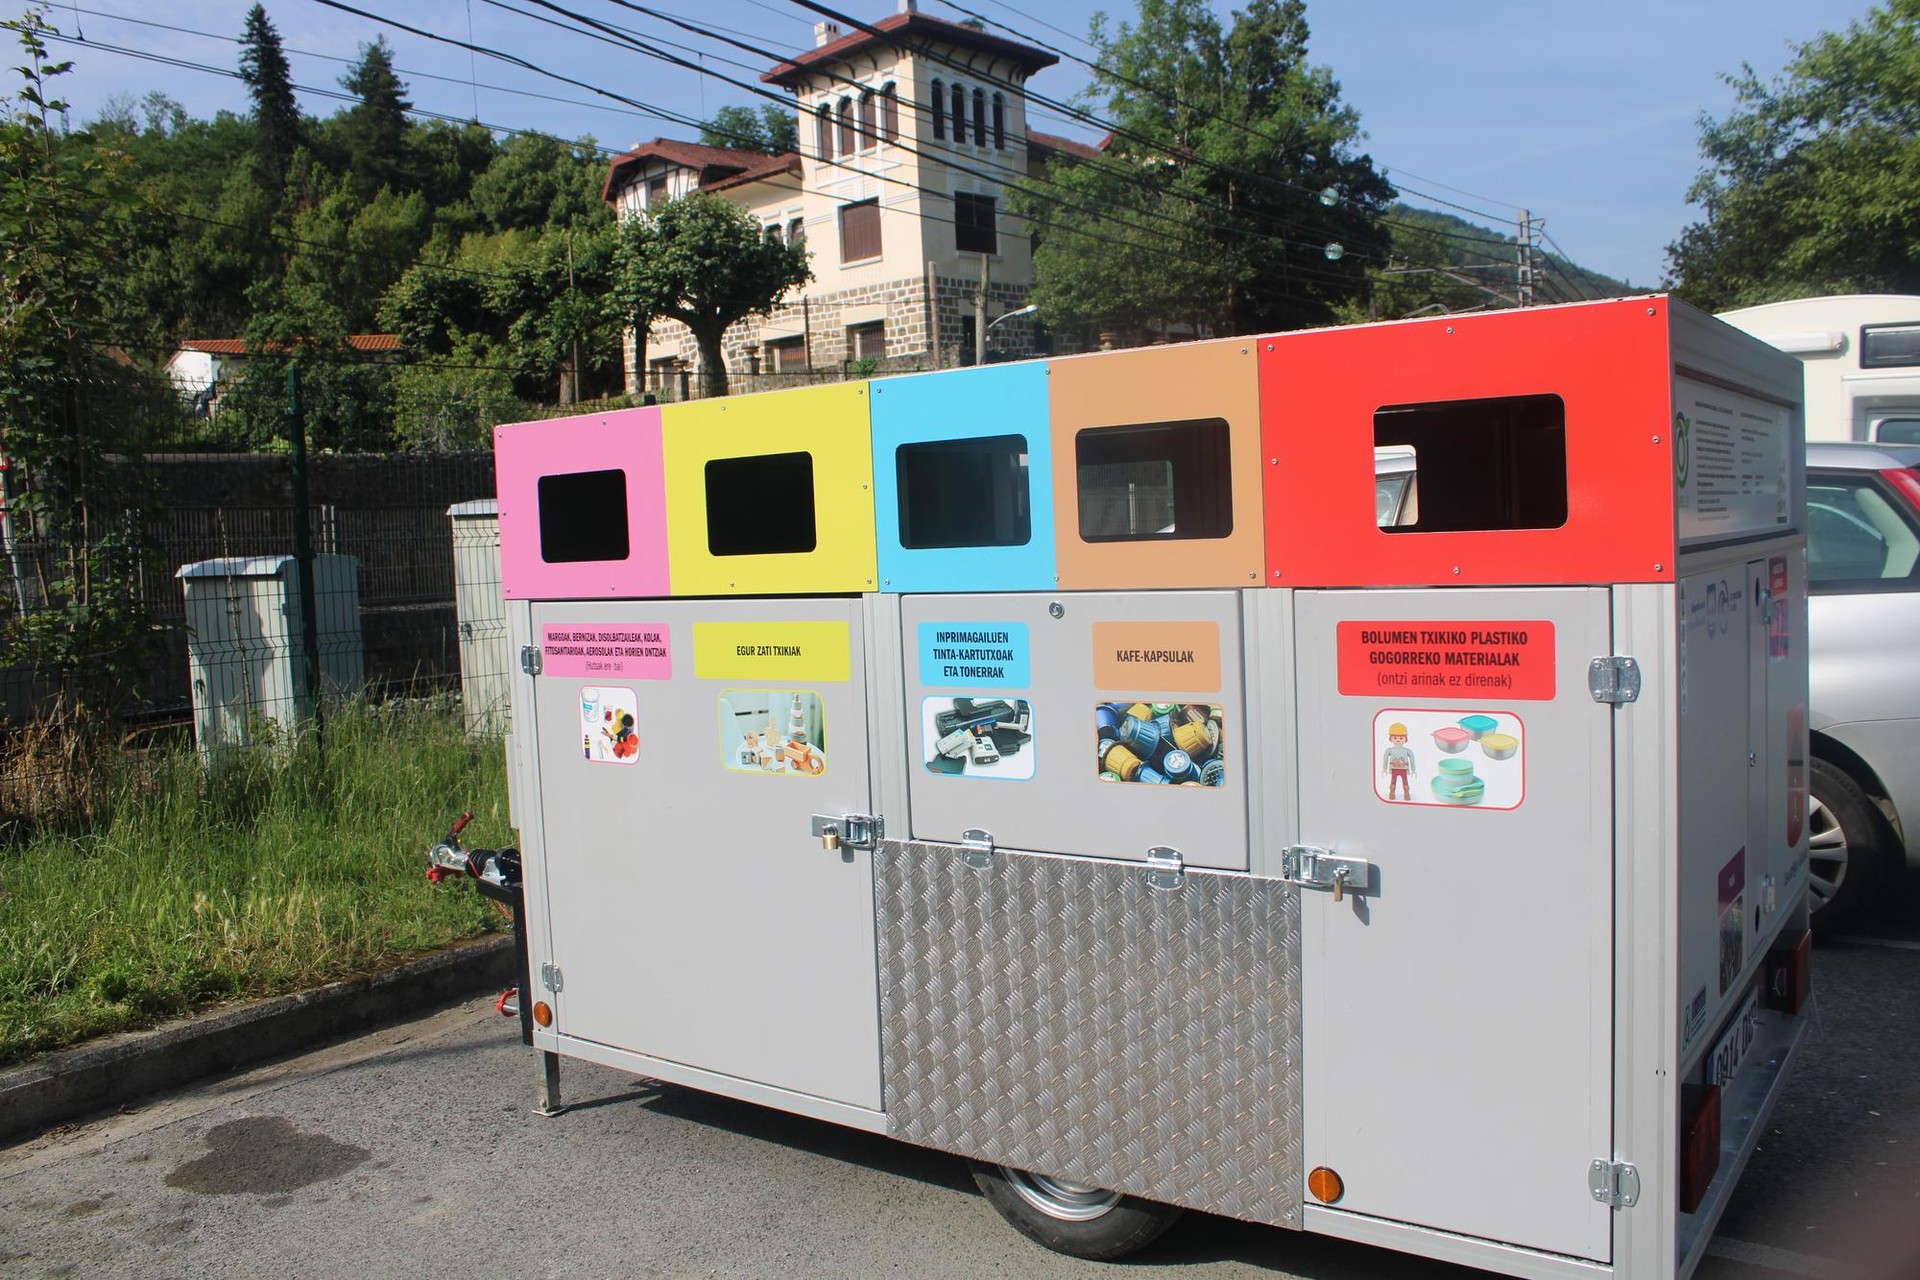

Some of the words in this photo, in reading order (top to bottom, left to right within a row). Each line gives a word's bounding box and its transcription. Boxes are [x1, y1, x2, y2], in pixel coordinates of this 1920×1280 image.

[936, 631, 1009, 644] INPRIMAGAILUEN
[1361, 630, 1418, 645] BOLUMEN
[1421, 631, 1467, 645] TXIKIKO
[1470, 632, 1528, 646] PLASTIKO
[586, 646, 613, 657] AEROSOLAK
[615, 646, 624, 657] ETA
[625, 647, 643, 657] HORIEN
[645, 647, 666, 658] ONTZIAK
[736, 645, 755, 656] EGUR
[756, 646, 772, 656] ZATI
[773, 646, 801, 656] TXIKIAK
[933, 648, 1014, 662] TINTA-KARTUTXOAK
[1116, 650, 1194, 664] KAFE-KAPSULAK
[1370, 651, 1441, 666] GOGORREKO
[1444, 652, 1520, 666] MATERIALAK
[943, 666, 958, 678] ETA
[959, 666, 1004, 679] TONERRAK
[1377, 672, 1408, 686] (ontzi
[1411, 672, 1446, 686] arinak
[1449, 676, 1461, 686] ez
[1465, 672, 1512, 690] direnak)
